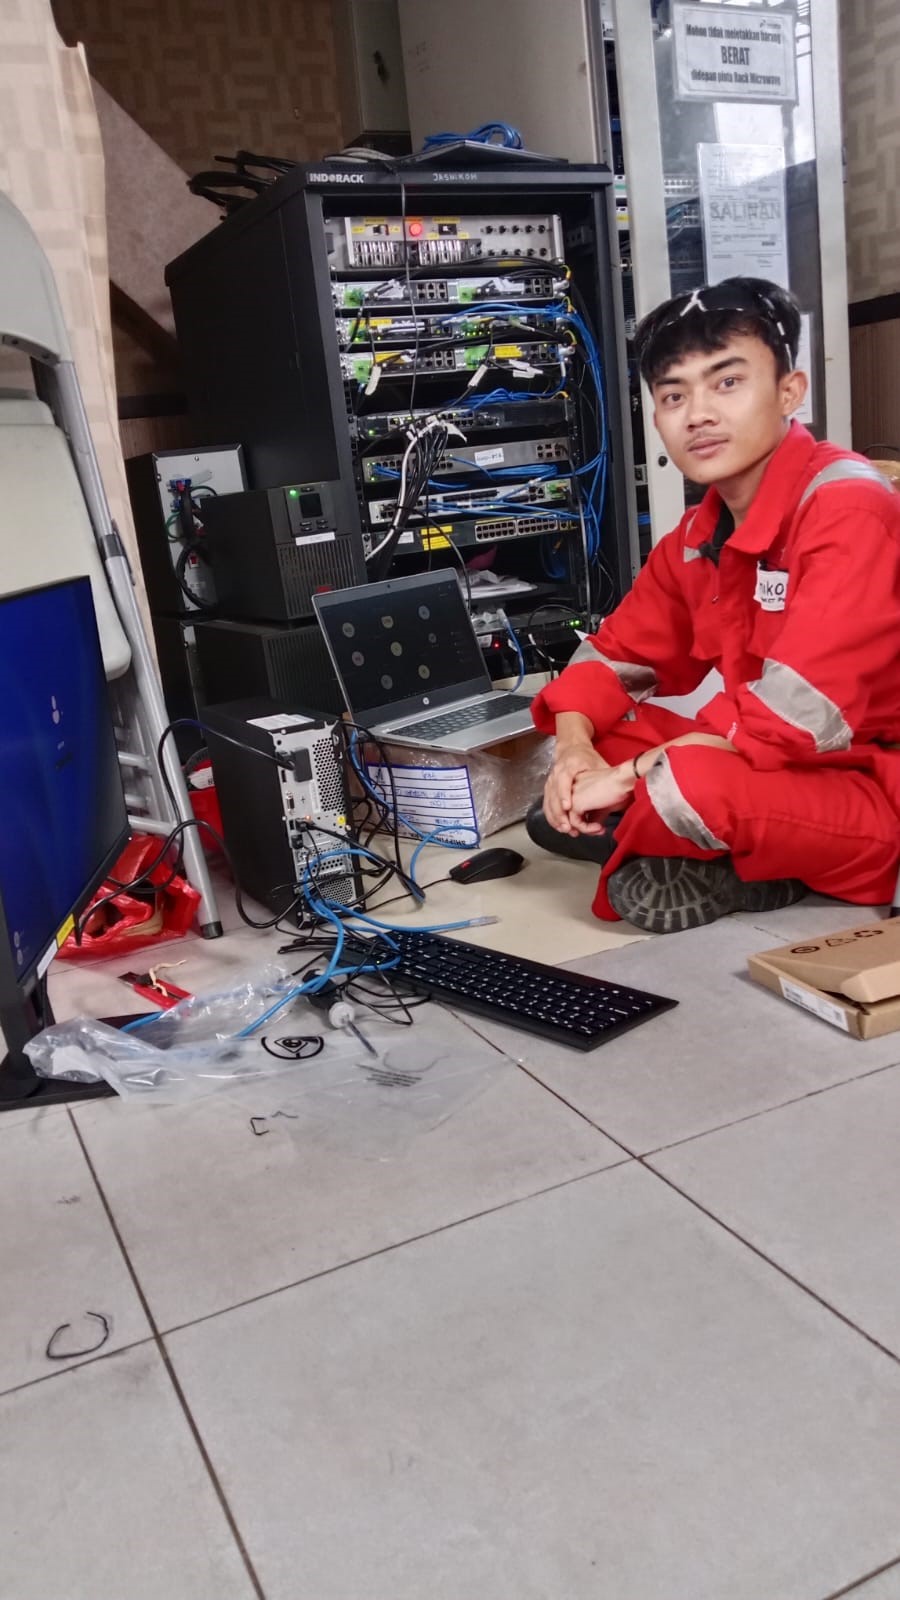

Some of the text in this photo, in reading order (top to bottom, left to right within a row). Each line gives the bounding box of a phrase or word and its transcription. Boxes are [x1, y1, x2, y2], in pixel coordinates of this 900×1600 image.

[708, 26, 723, 38] tidak
[720, 45, 750, 65] BERAT
[309, 173, 364, 183] INDORACK
